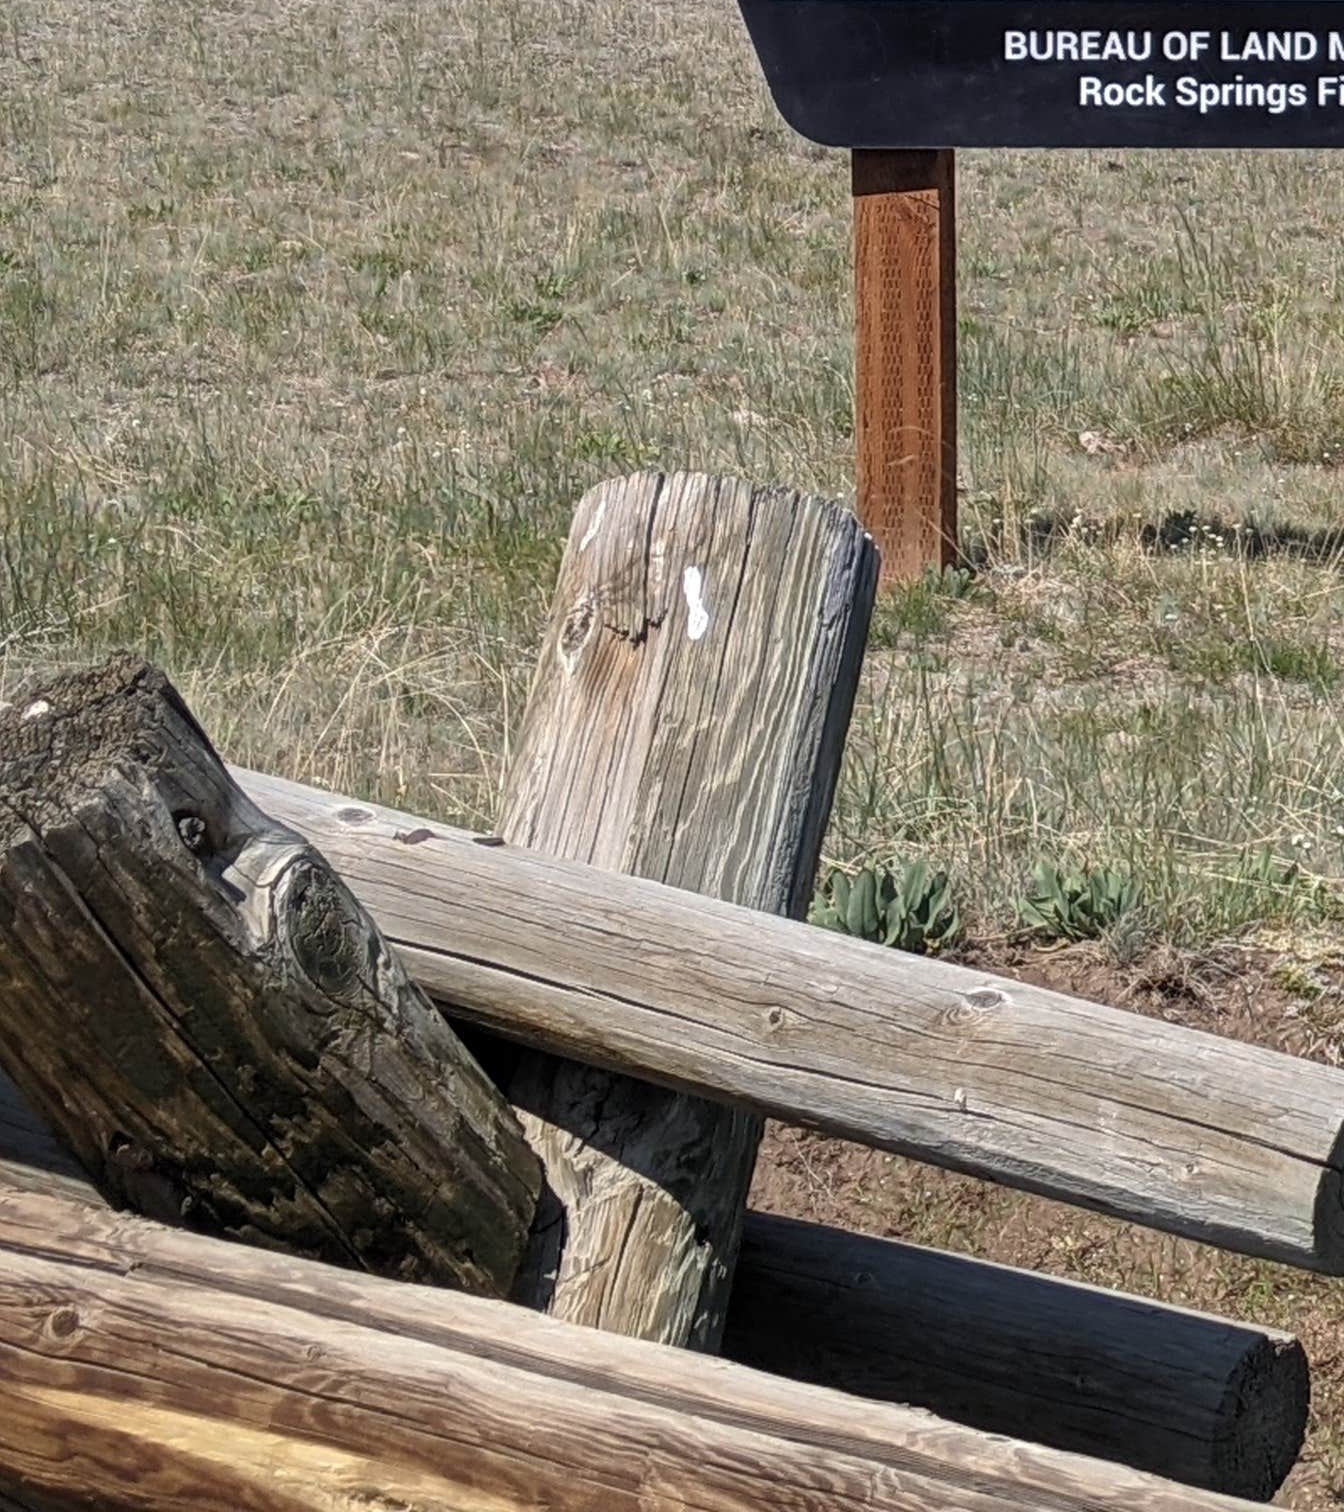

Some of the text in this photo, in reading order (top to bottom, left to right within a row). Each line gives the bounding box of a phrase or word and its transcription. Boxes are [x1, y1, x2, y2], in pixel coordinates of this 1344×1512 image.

[1005, 31, 1151, 61] BUREAU
[1163, 31, 1210, 61] OF
[1221, 31, 1318, 61] LAND
[1079, 75, 1166, 106] Rock
[1175, 76, 1307, 114] Springs
